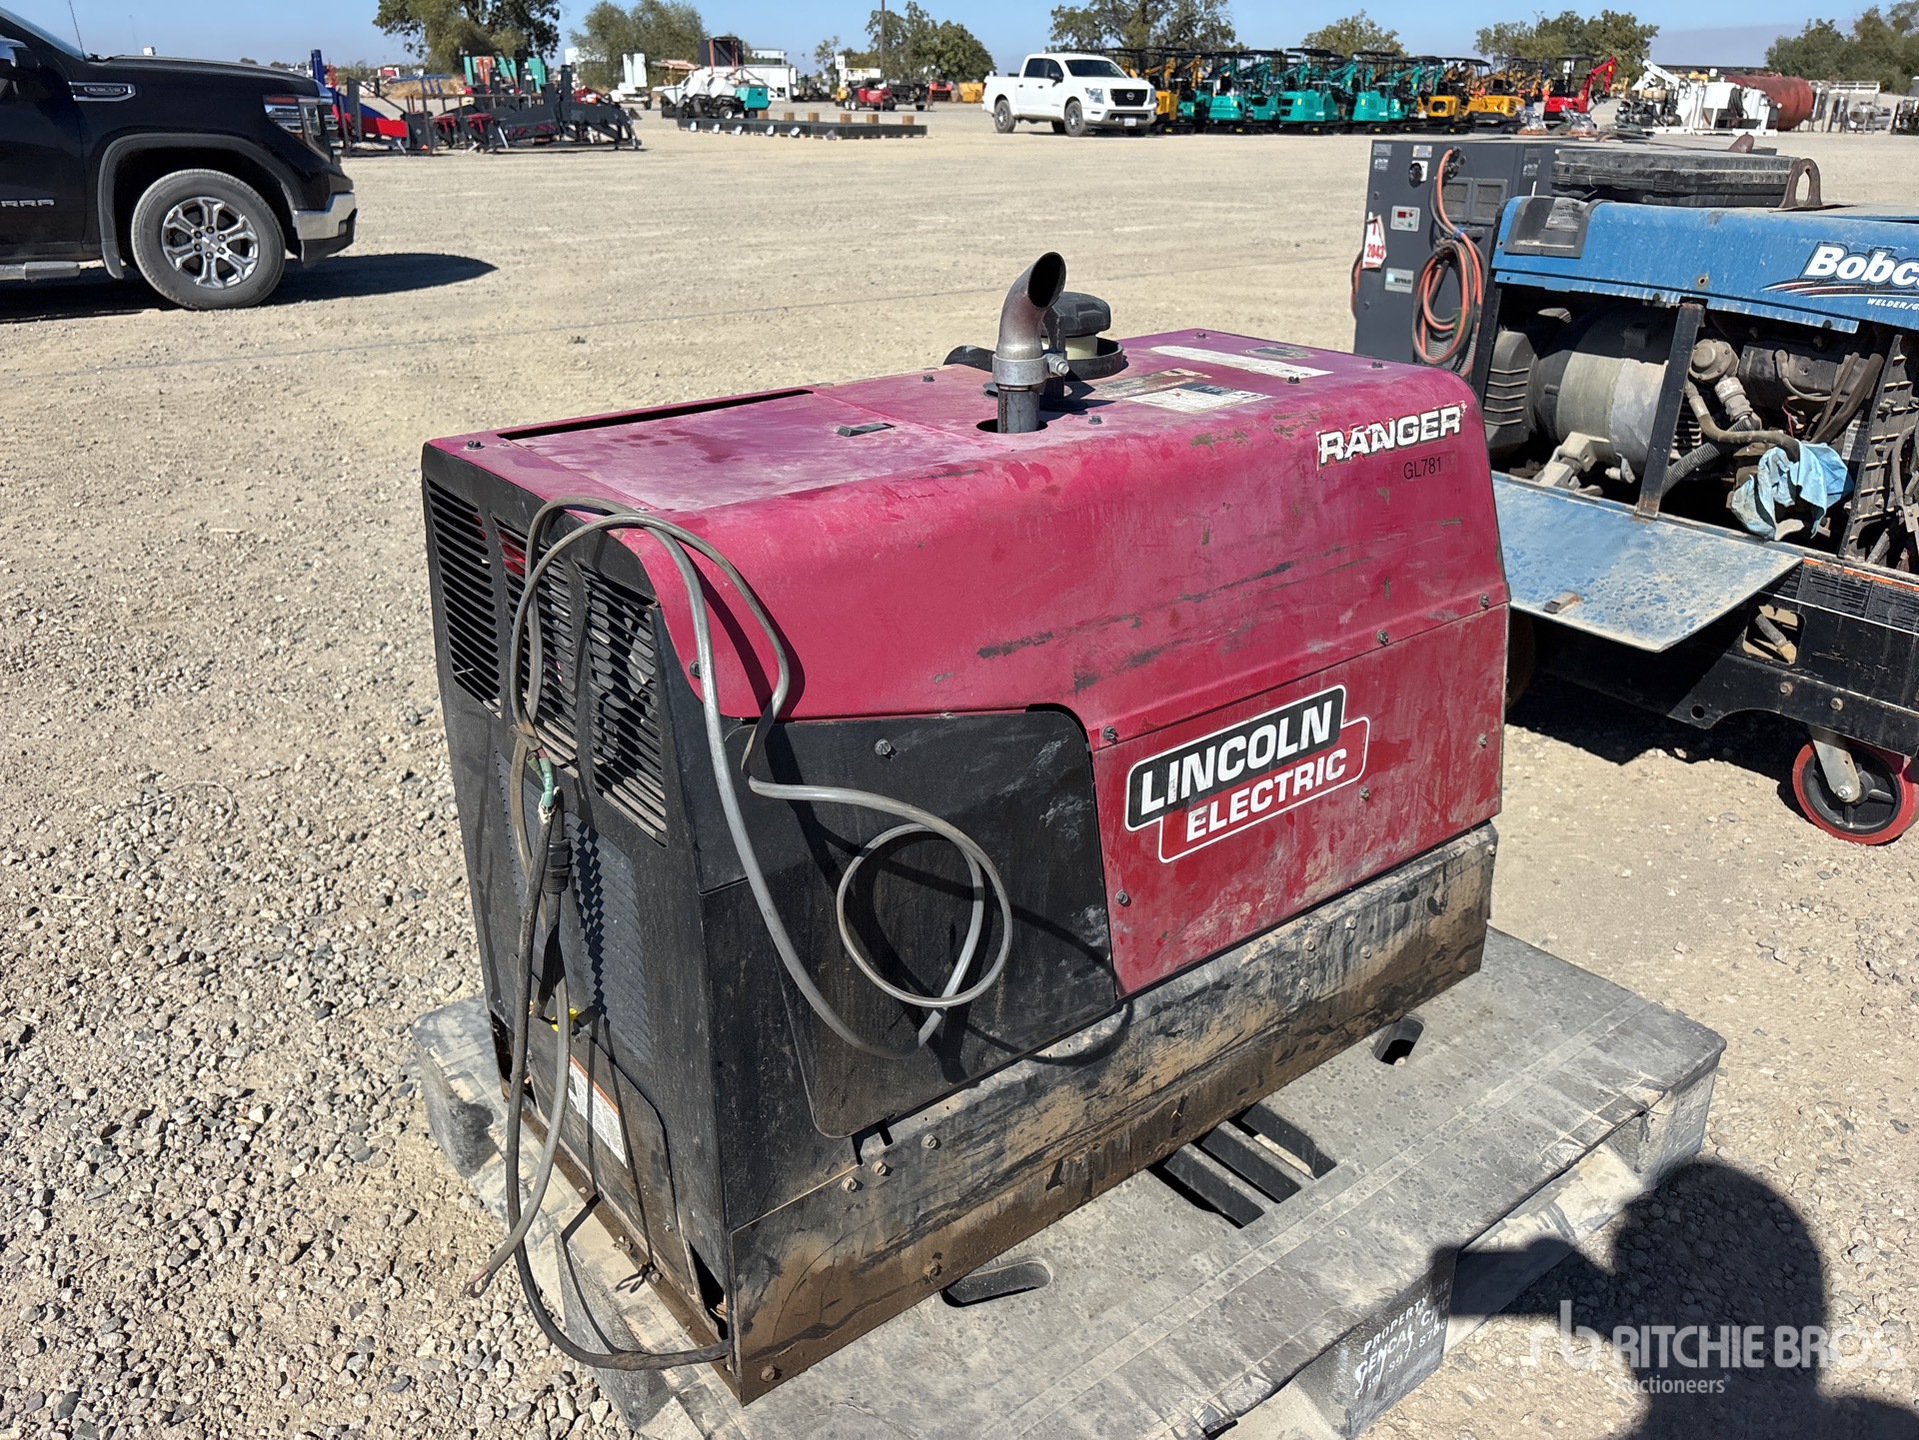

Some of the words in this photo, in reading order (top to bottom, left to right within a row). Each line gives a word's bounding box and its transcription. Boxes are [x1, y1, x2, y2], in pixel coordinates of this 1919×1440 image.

[1804, 245, 1919, 286] Bobc
[1867, 297, 1919, 310] WELDER/G
[1320, 405, 1461, 464] RANGER
[1403, 457, 1442, 480] GL781
[1141, 700, 1333, 815] LINCOLN
[1186, 748, 1347, 843] ELECTRIC
[1361, 1297, 1428, 1355] PROPERTY
